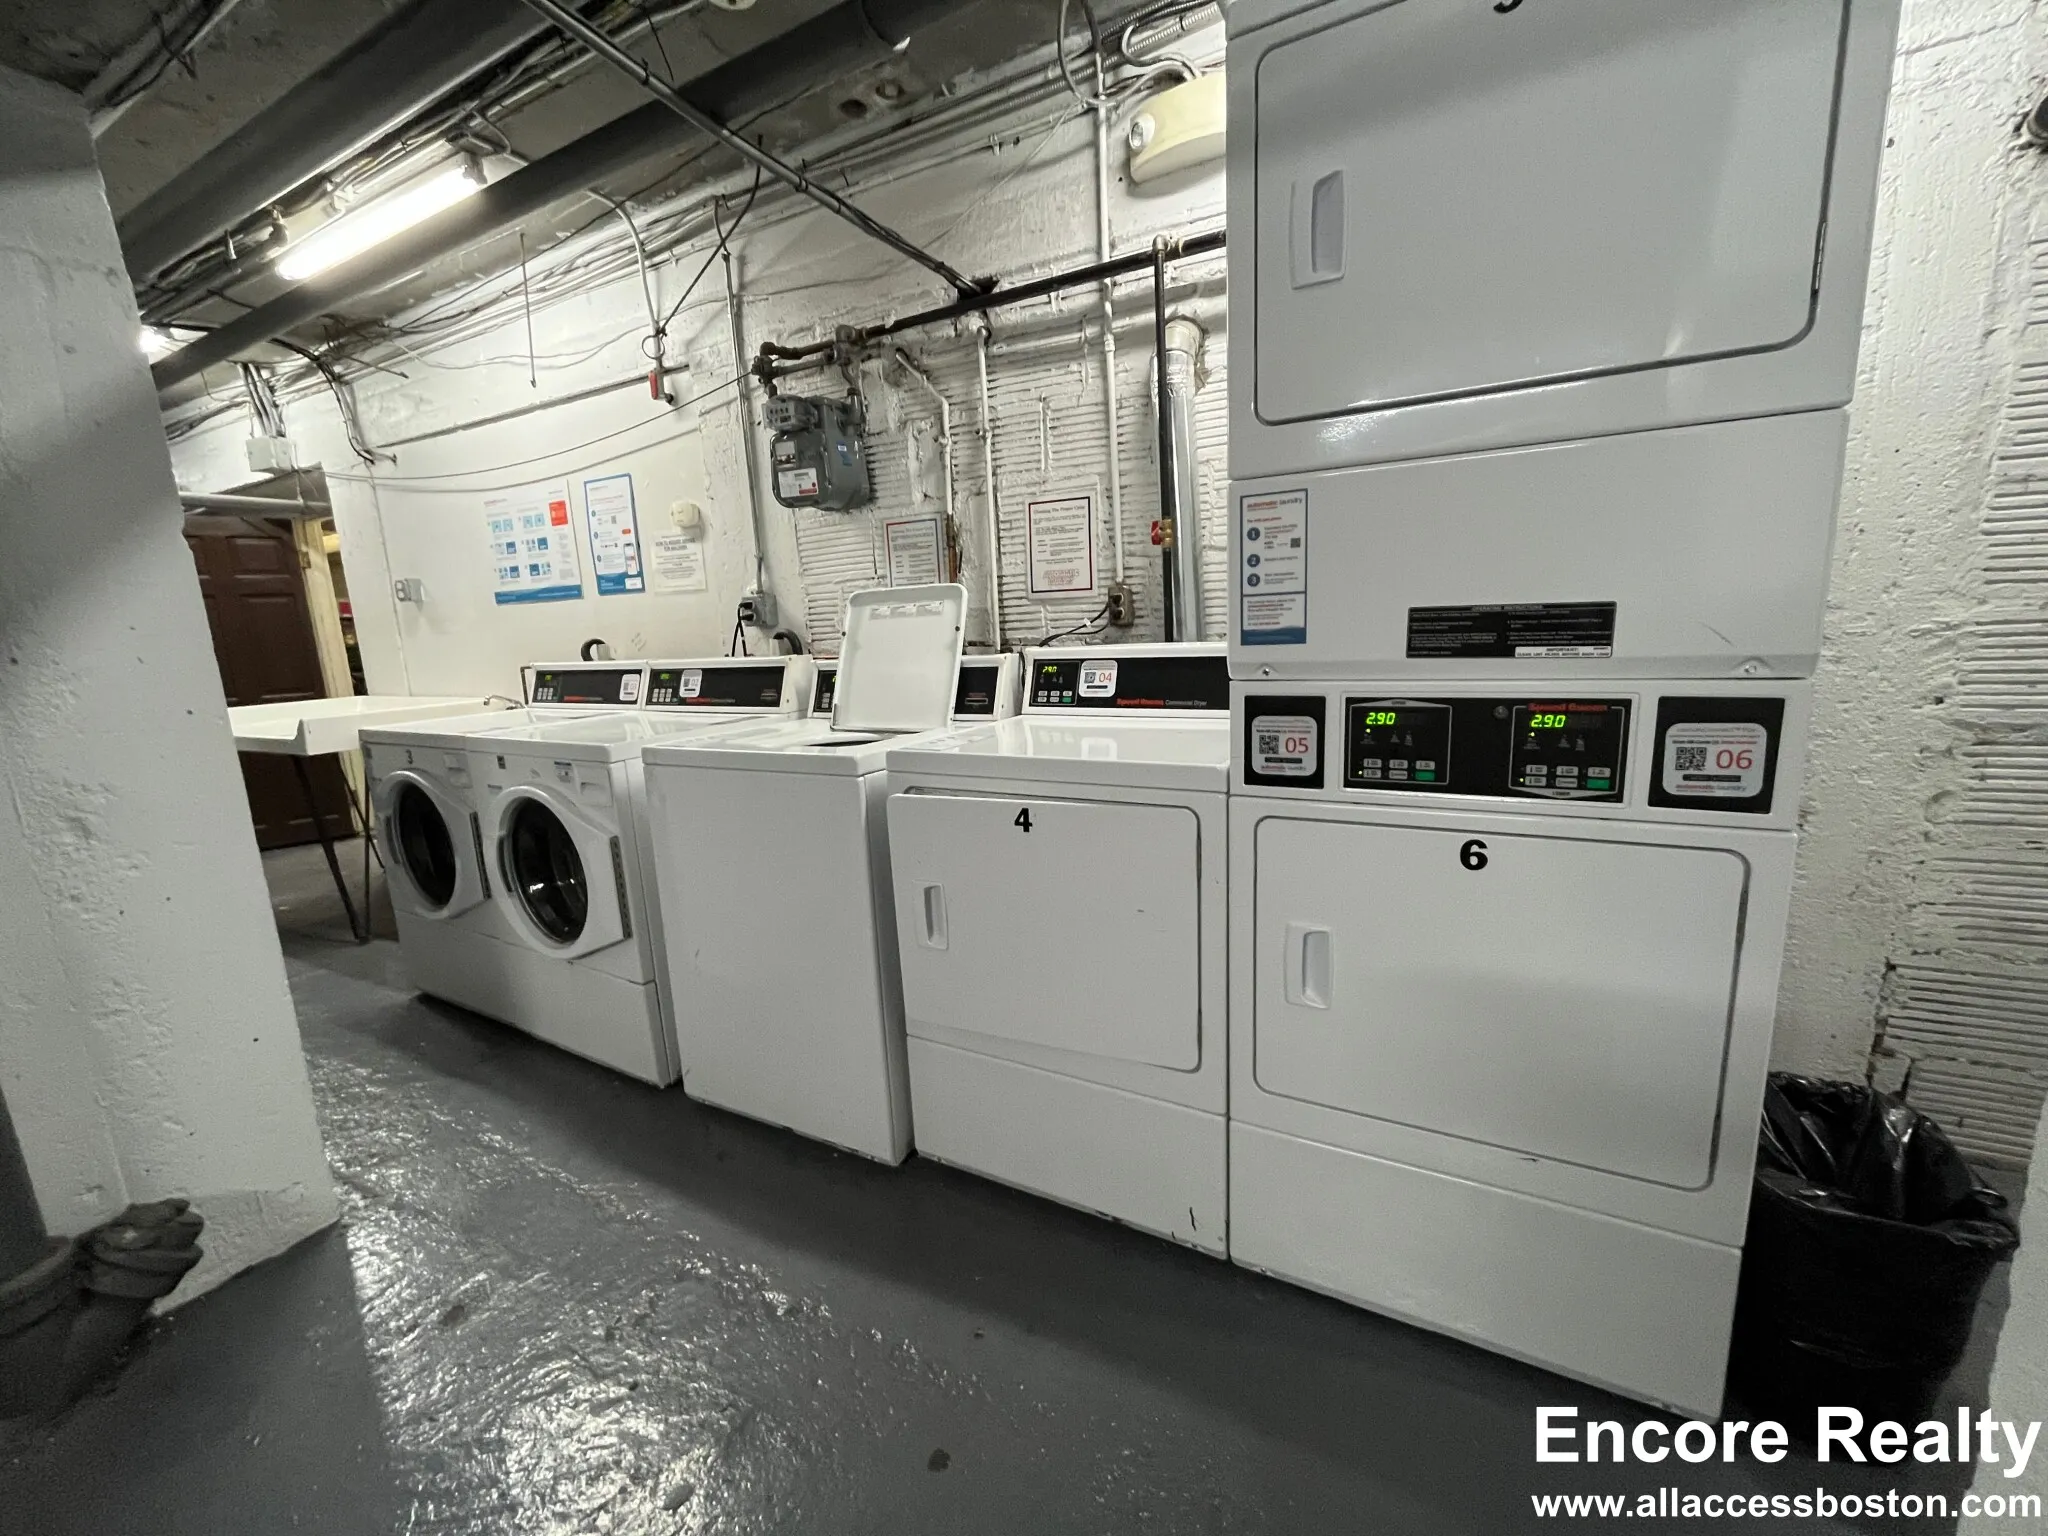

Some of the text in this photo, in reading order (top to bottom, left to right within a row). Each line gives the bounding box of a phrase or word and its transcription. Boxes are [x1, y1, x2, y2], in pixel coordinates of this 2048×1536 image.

[1098, 672, 1112, 683] 04
[1366, 712, 1395, 725] 2.90
[1530, 714, 1566, 727] 2.90
[1285, 737, 1309, 753] 05
[405, 748, 413, 765] 3
[1716, 749, 1753, 770] 06
[1014, 807, 1033, 833] 4
[1460, 839, 1488, 870] 6
